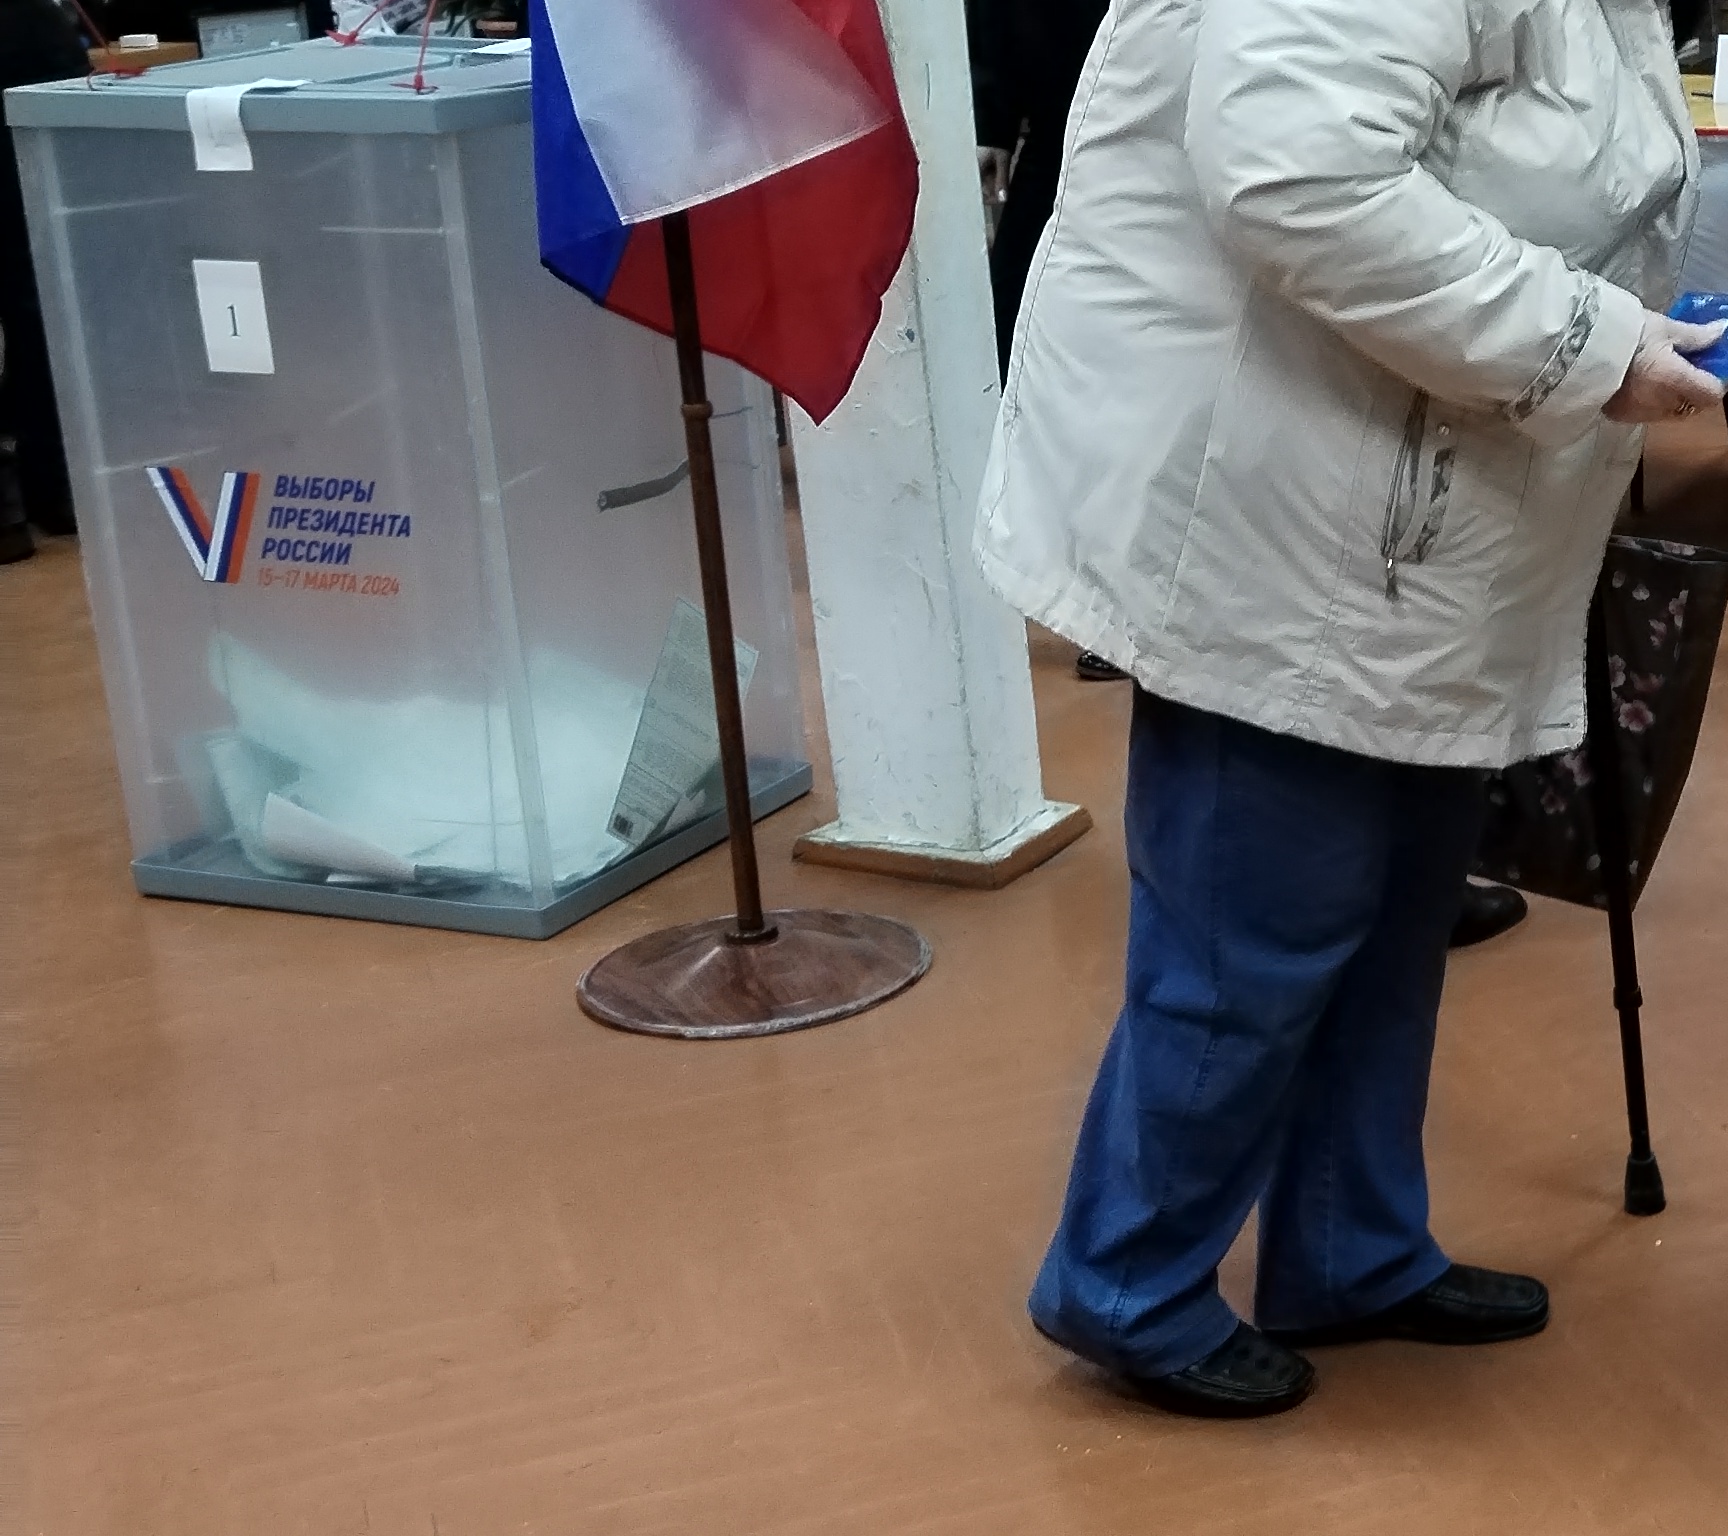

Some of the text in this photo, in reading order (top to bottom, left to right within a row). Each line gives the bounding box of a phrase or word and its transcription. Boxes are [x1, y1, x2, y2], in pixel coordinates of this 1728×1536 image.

[226, 303, 241, 338] 1
[273, 474, 376, 503] ВЫБОРЫ
[267, 506, 412, 538] ПРЕЗИДЕНТА
[260, 537, 353, 565] РОССИИ
[303, 570, 358, 593] МАРТА
[361, 575, 401, 596] 2024
